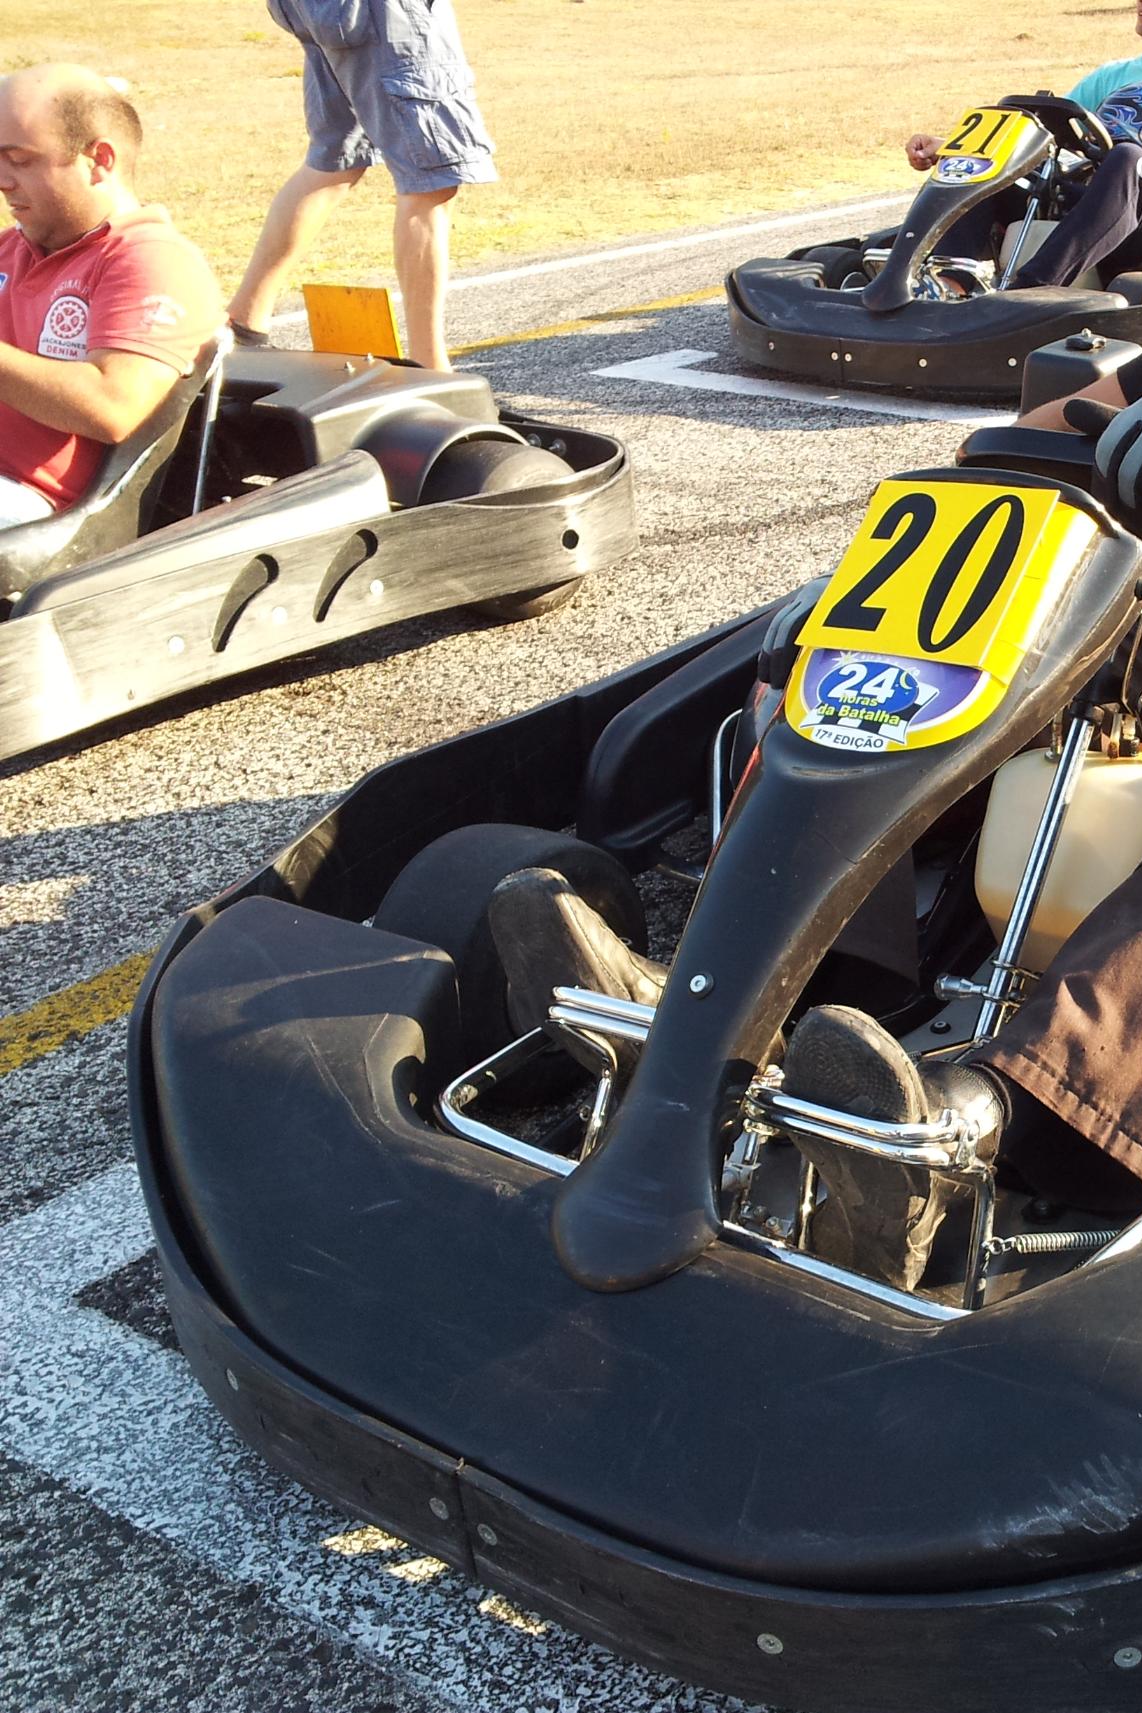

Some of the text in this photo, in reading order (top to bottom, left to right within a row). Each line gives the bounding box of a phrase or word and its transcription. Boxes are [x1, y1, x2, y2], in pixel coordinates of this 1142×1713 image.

[944, 113, 1011, 155] 21
[46, 345, 78, 357] DENIM
[822, 493, 1025, 653] 20
[827, 663, 900, 704] 24
[817, 703, 900, 727] da Batalha
[833, 734, 884, 749] EDIÇÃO
